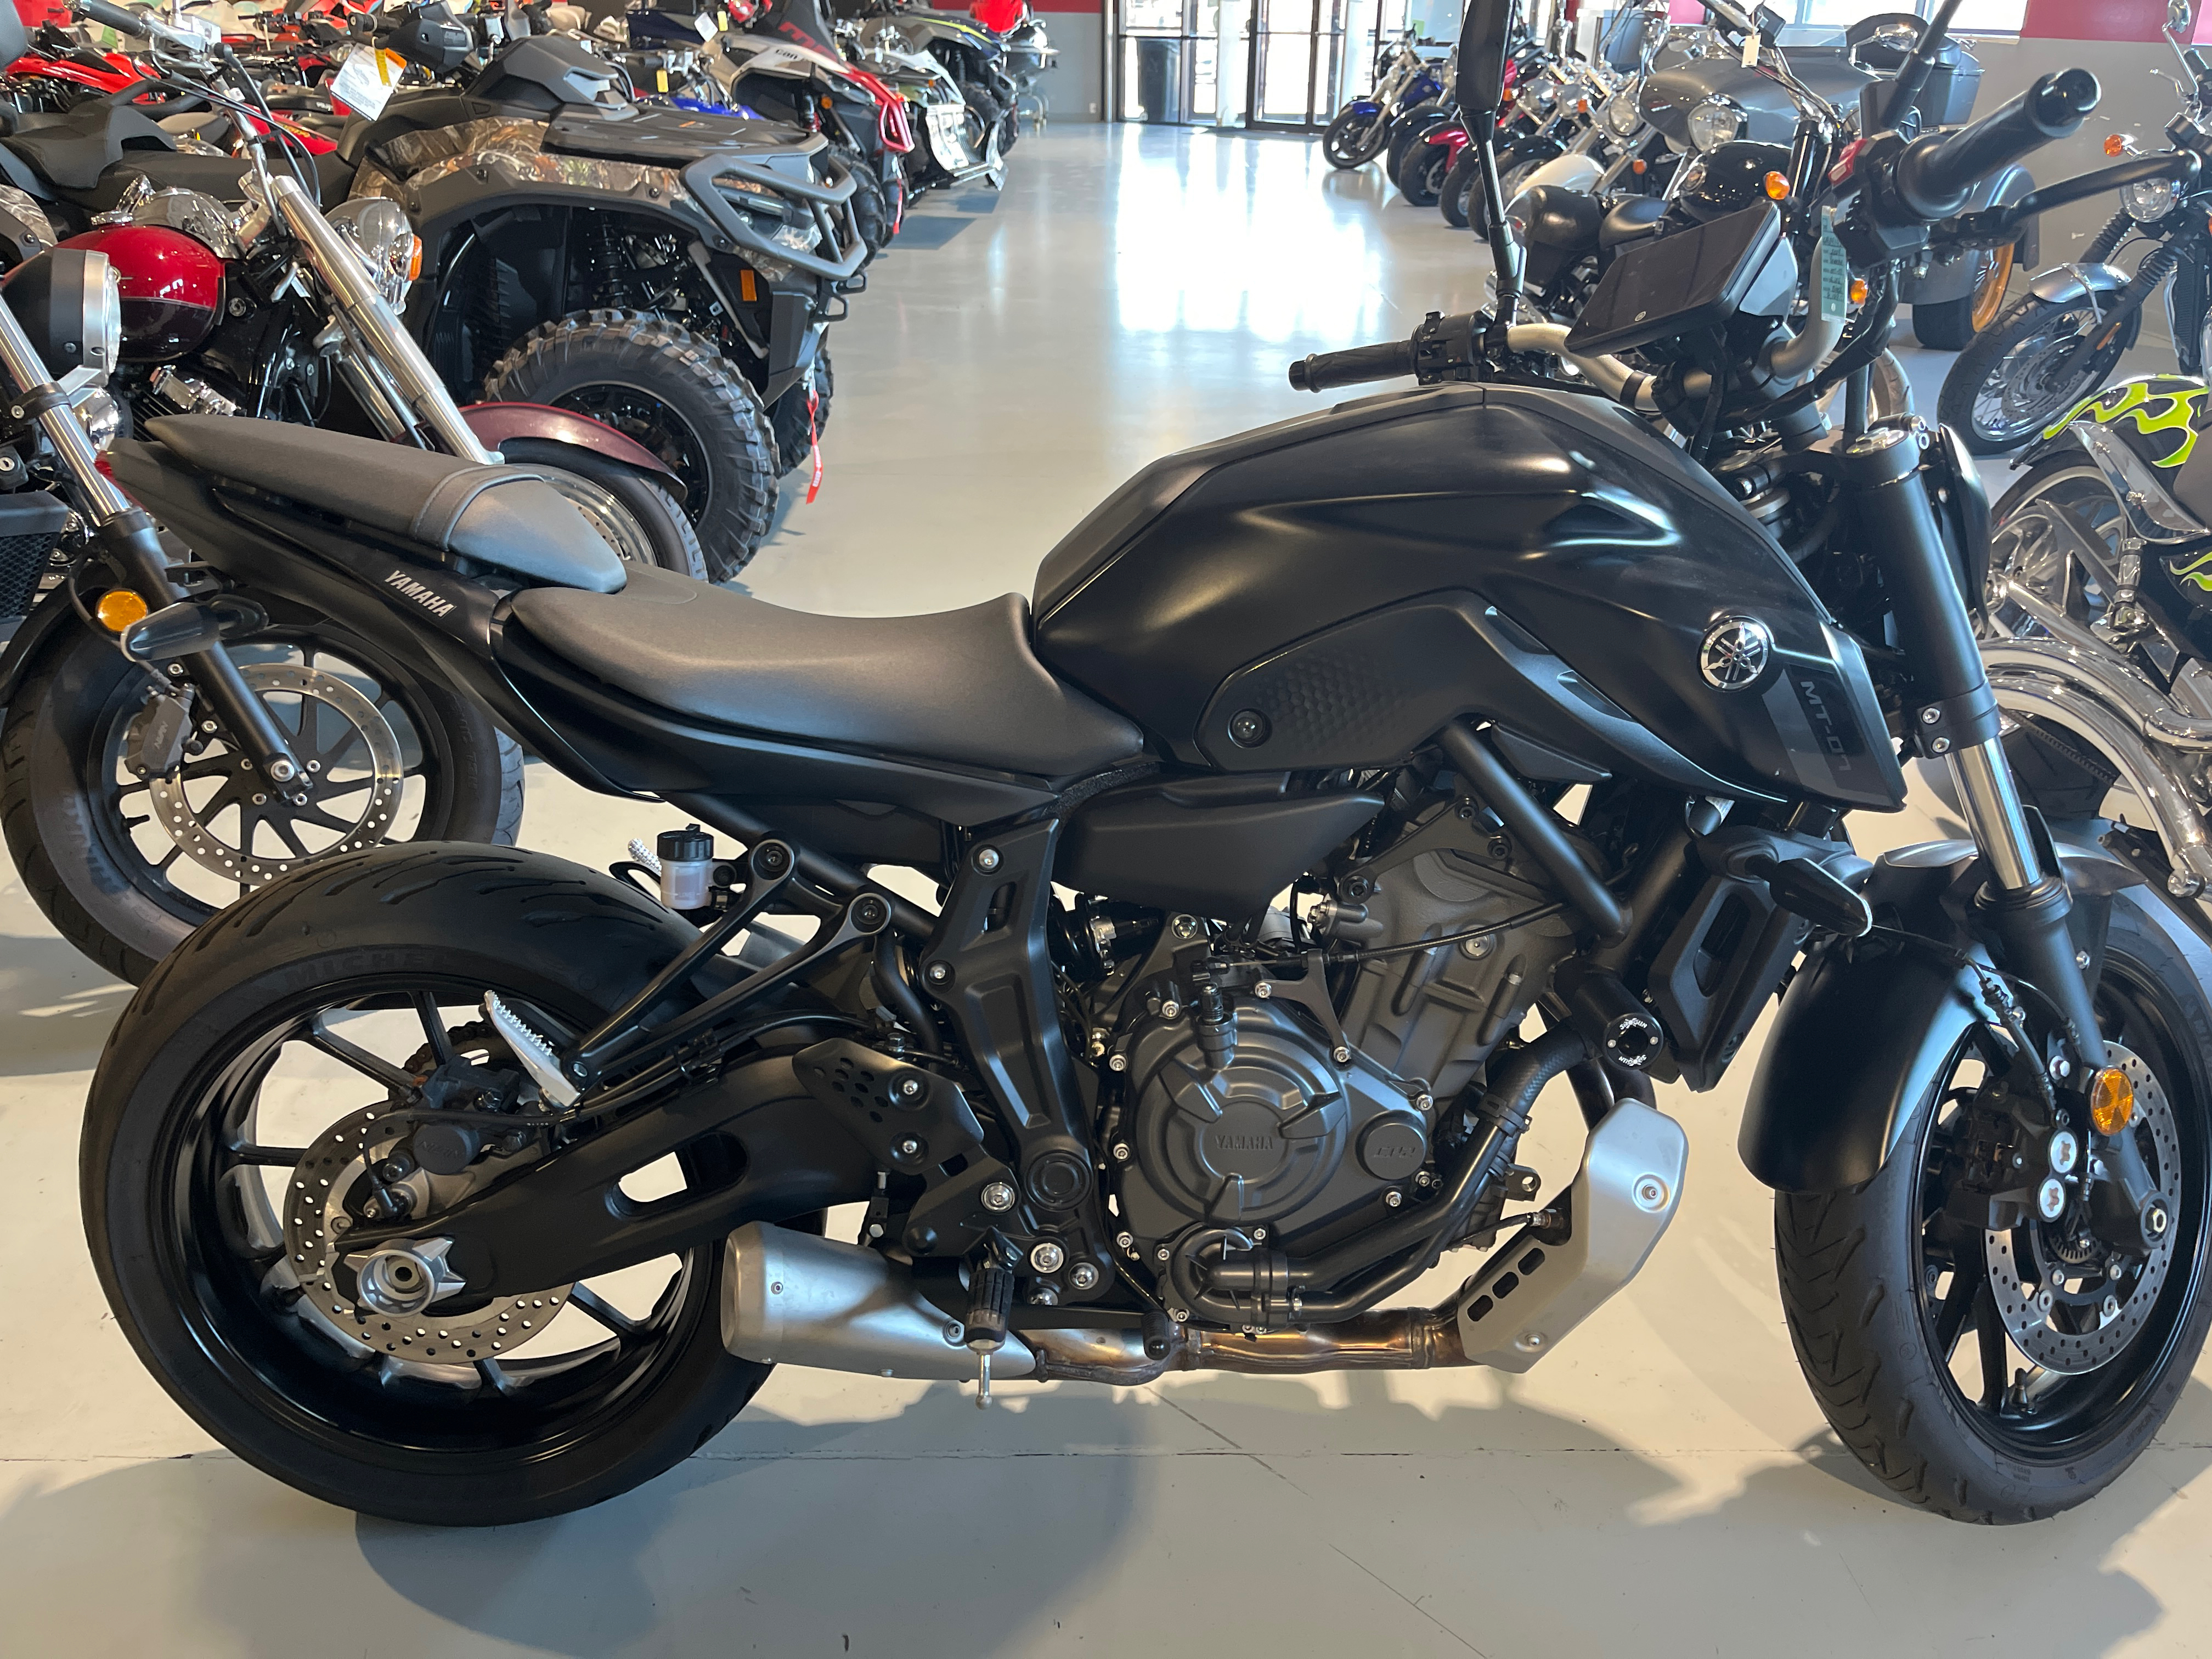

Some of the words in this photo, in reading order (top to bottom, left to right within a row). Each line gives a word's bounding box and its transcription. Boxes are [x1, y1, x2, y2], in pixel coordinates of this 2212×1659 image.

[384, 569, 456, 619] YAMAHA
[1799, 681, 1852, 771] MT-07
[1215, 1135, 1273, 1150] YAMAHA
